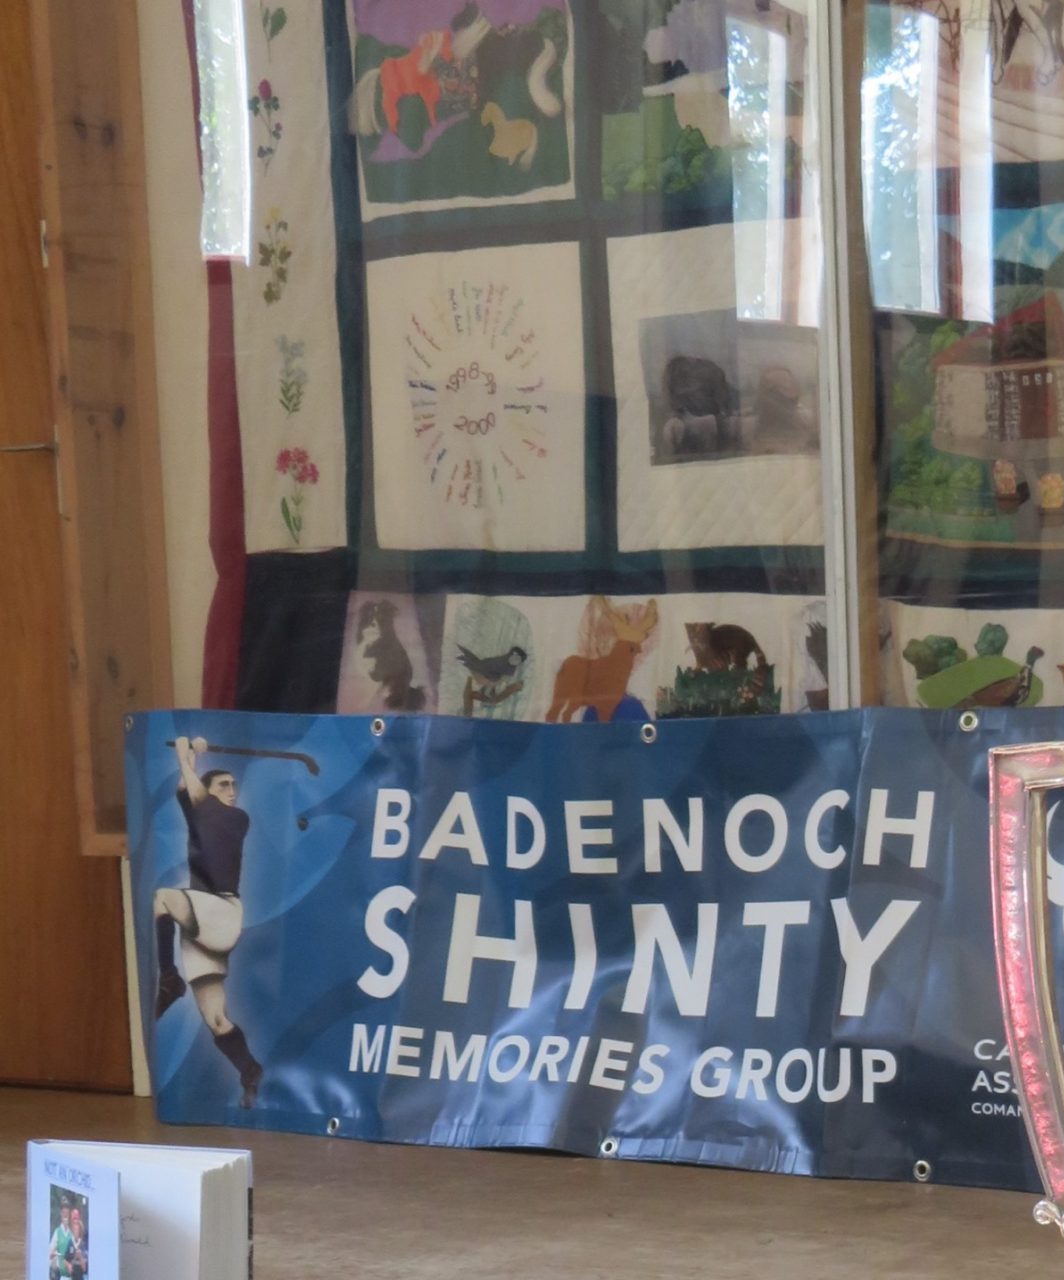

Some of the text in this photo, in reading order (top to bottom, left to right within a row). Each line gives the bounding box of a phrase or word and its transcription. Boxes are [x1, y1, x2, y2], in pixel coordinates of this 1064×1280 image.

[452, 411, 496, 435] 2000
[370, 787, 936, 875] BADENOCH
[356, 884, 922, 1018] SHINTY
[348, 1023, 671, 1096] MEMORIES
[690, 1045, 898, 1104] GROUP
